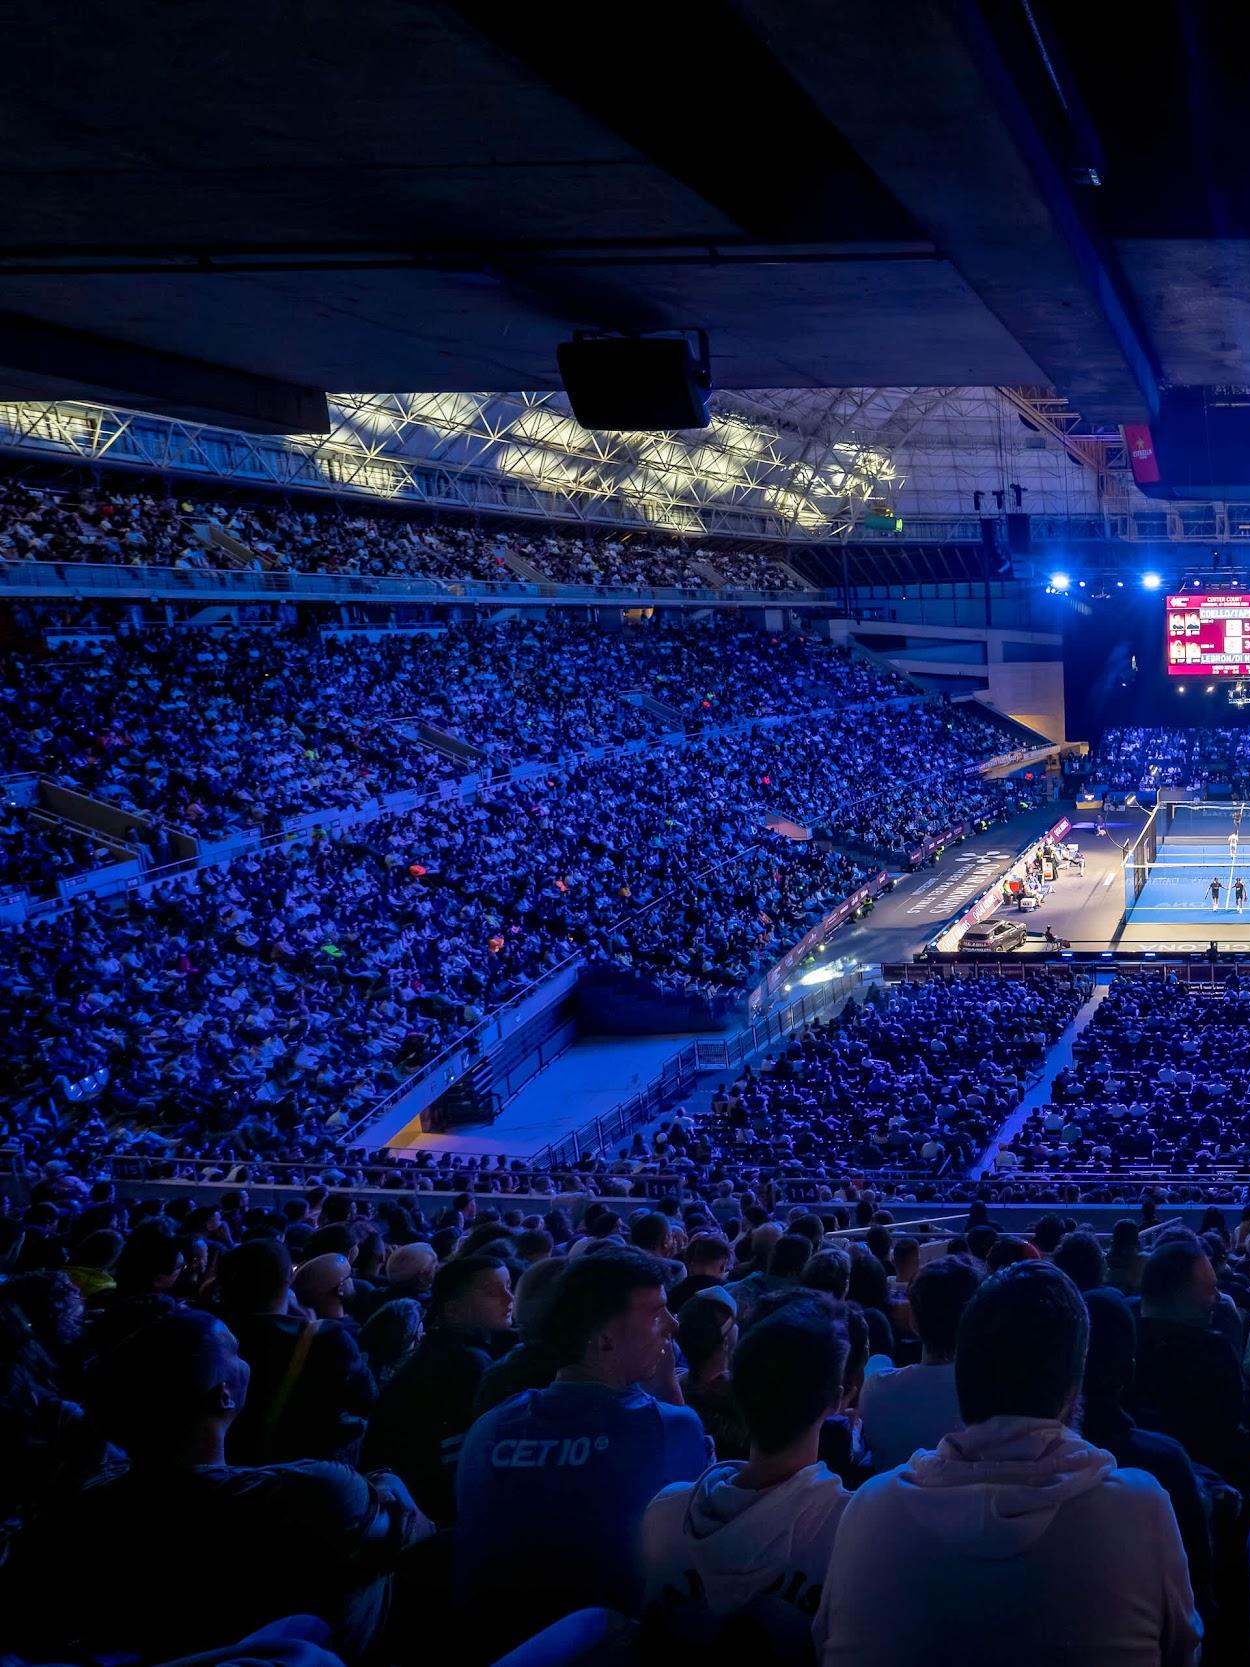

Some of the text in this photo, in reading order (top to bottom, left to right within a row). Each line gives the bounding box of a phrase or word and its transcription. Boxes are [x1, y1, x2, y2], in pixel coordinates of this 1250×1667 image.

[1244, 622, 1250, 631] 5
[1244, 640, 1250, 649] 3
[928, 883, 976, 914] AIRWAYS
[652, 1182, 676, 1195] 114
[791, 1187, 816, 1199] 114
